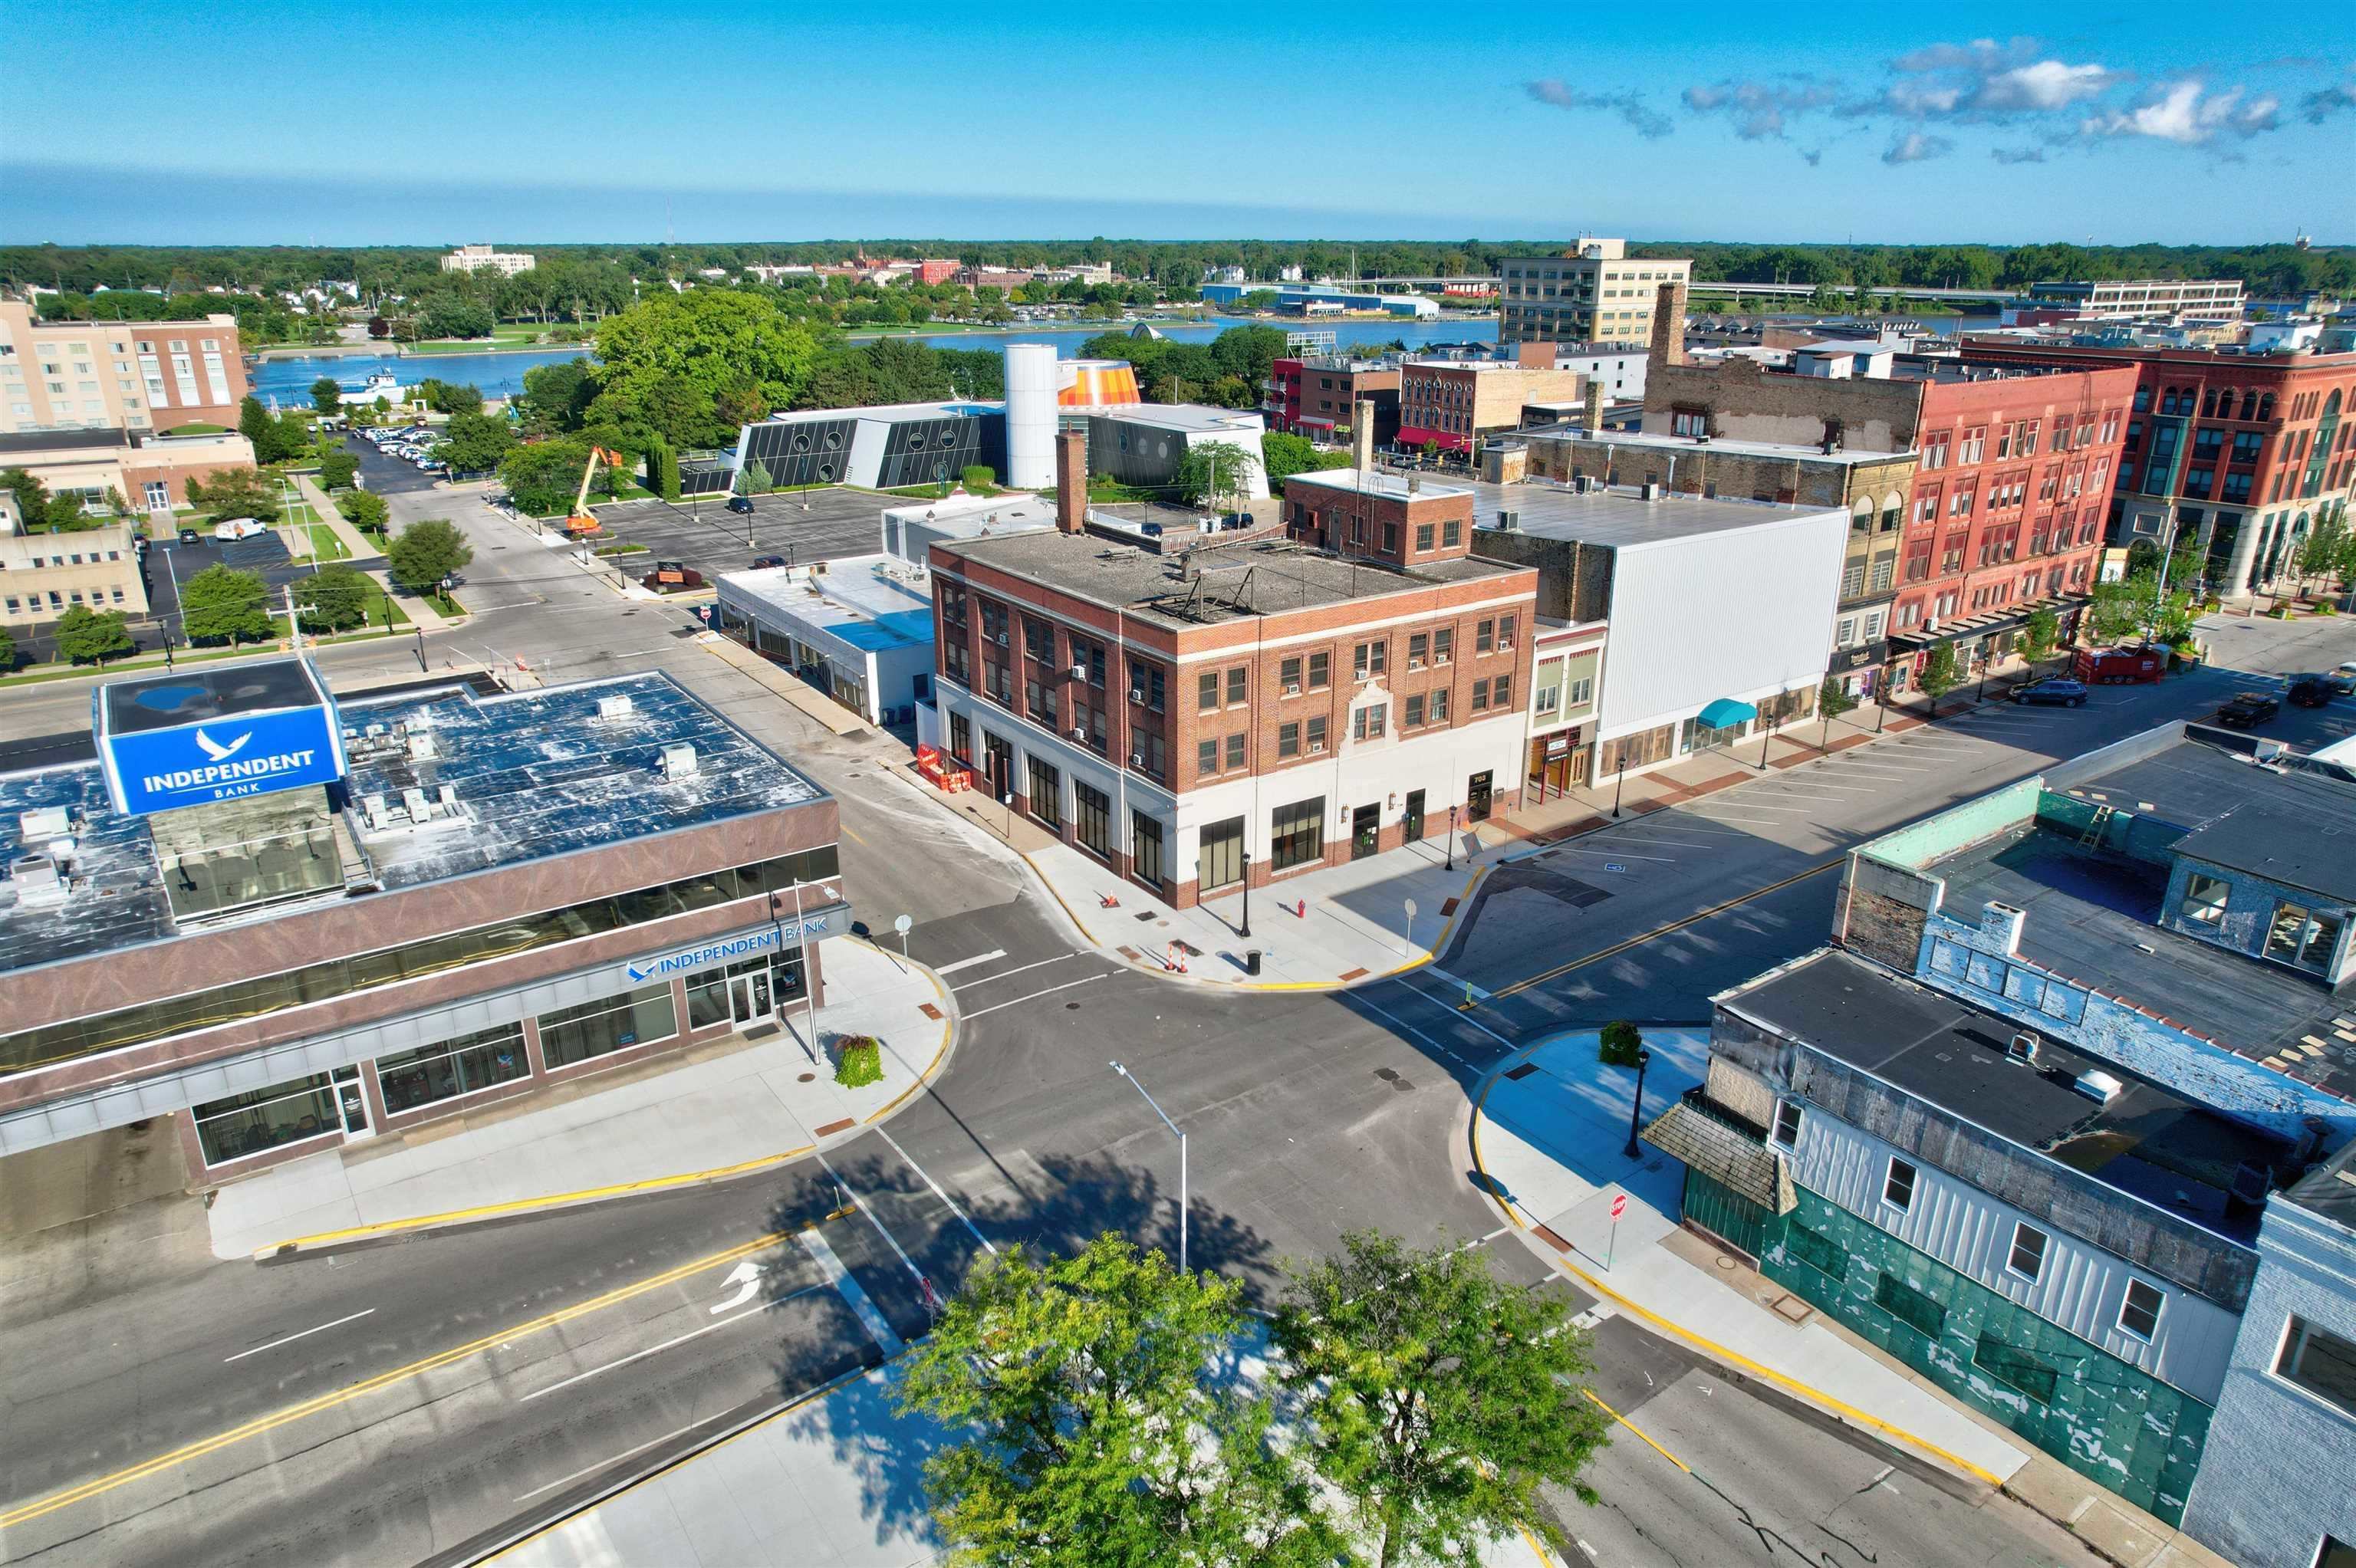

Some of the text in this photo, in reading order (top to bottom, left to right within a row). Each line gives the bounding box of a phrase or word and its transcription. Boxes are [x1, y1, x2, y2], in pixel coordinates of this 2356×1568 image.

[143, 750, 314, 792] INDEPENDENT
[215, 784, 260, 798] BANK
[660, 929, 781, 972] INDEPENDENT
[1610, 1198, 1626, 1213] STOP
